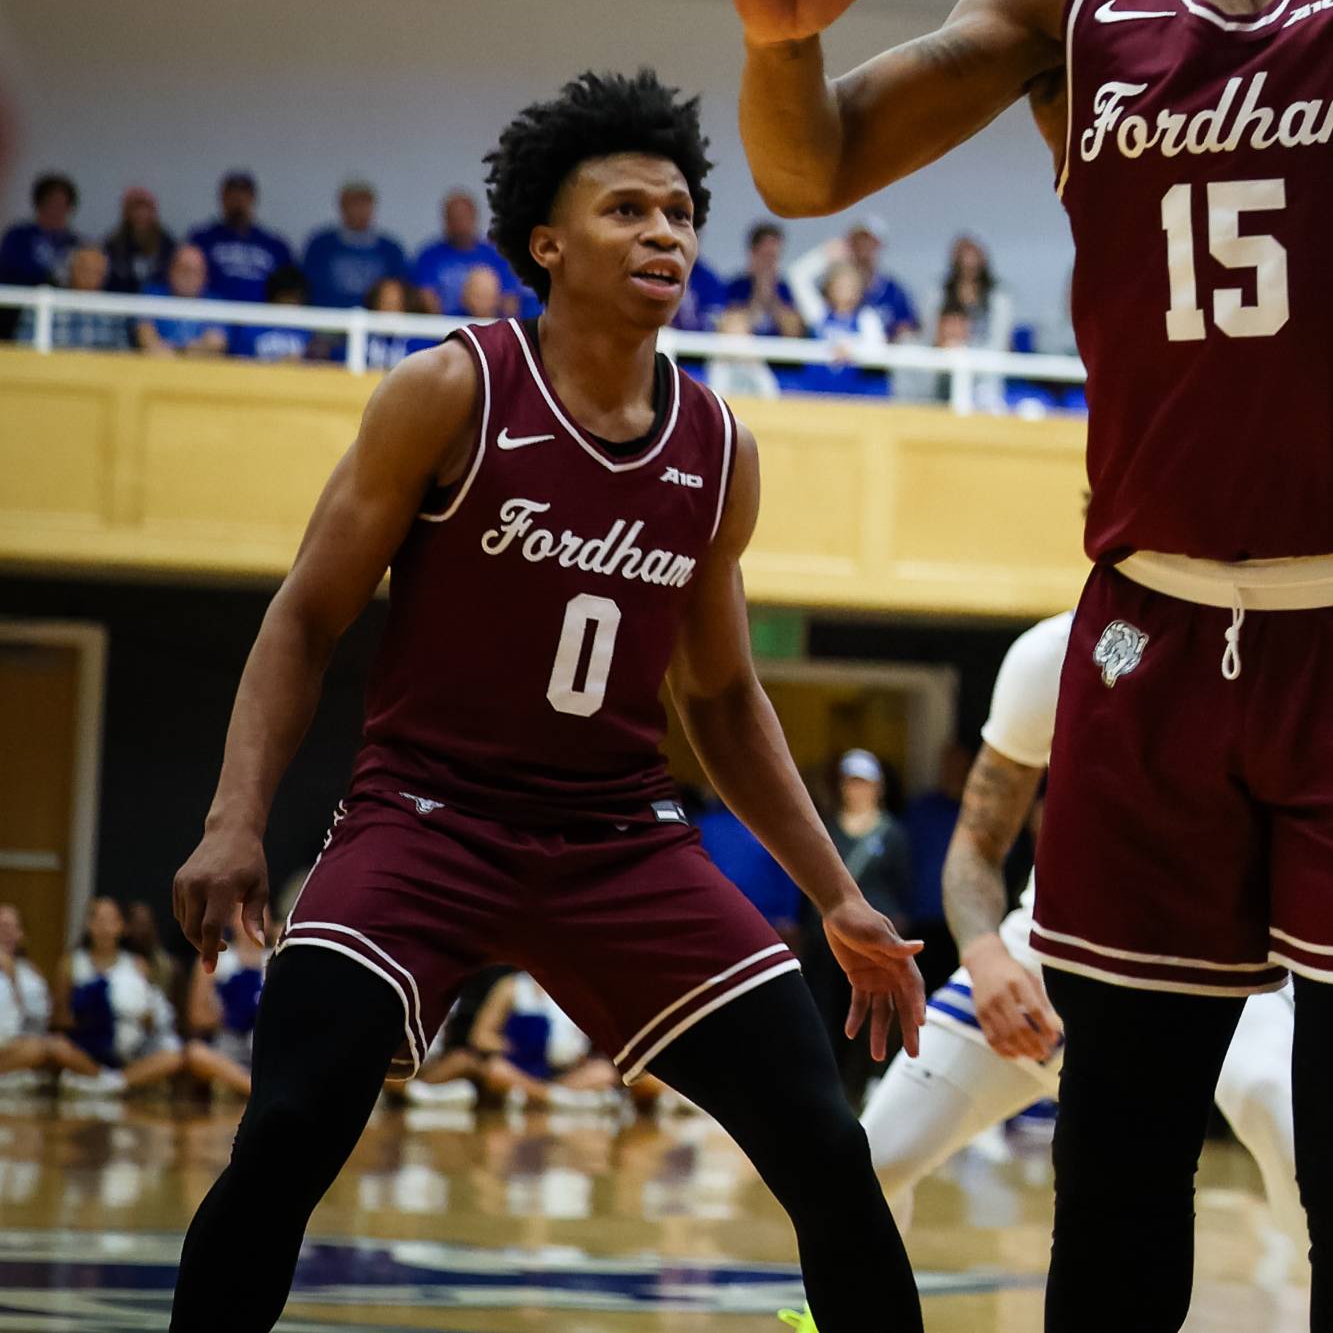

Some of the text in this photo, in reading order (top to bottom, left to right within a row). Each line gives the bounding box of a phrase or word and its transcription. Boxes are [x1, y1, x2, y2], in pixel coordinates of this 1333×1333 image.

[1161, 178, 1290, 342] 15
[659, 466, 704, 489] A10
[481, 498, 696, 588] Fordham
[546, 592, 622, 718] 0
